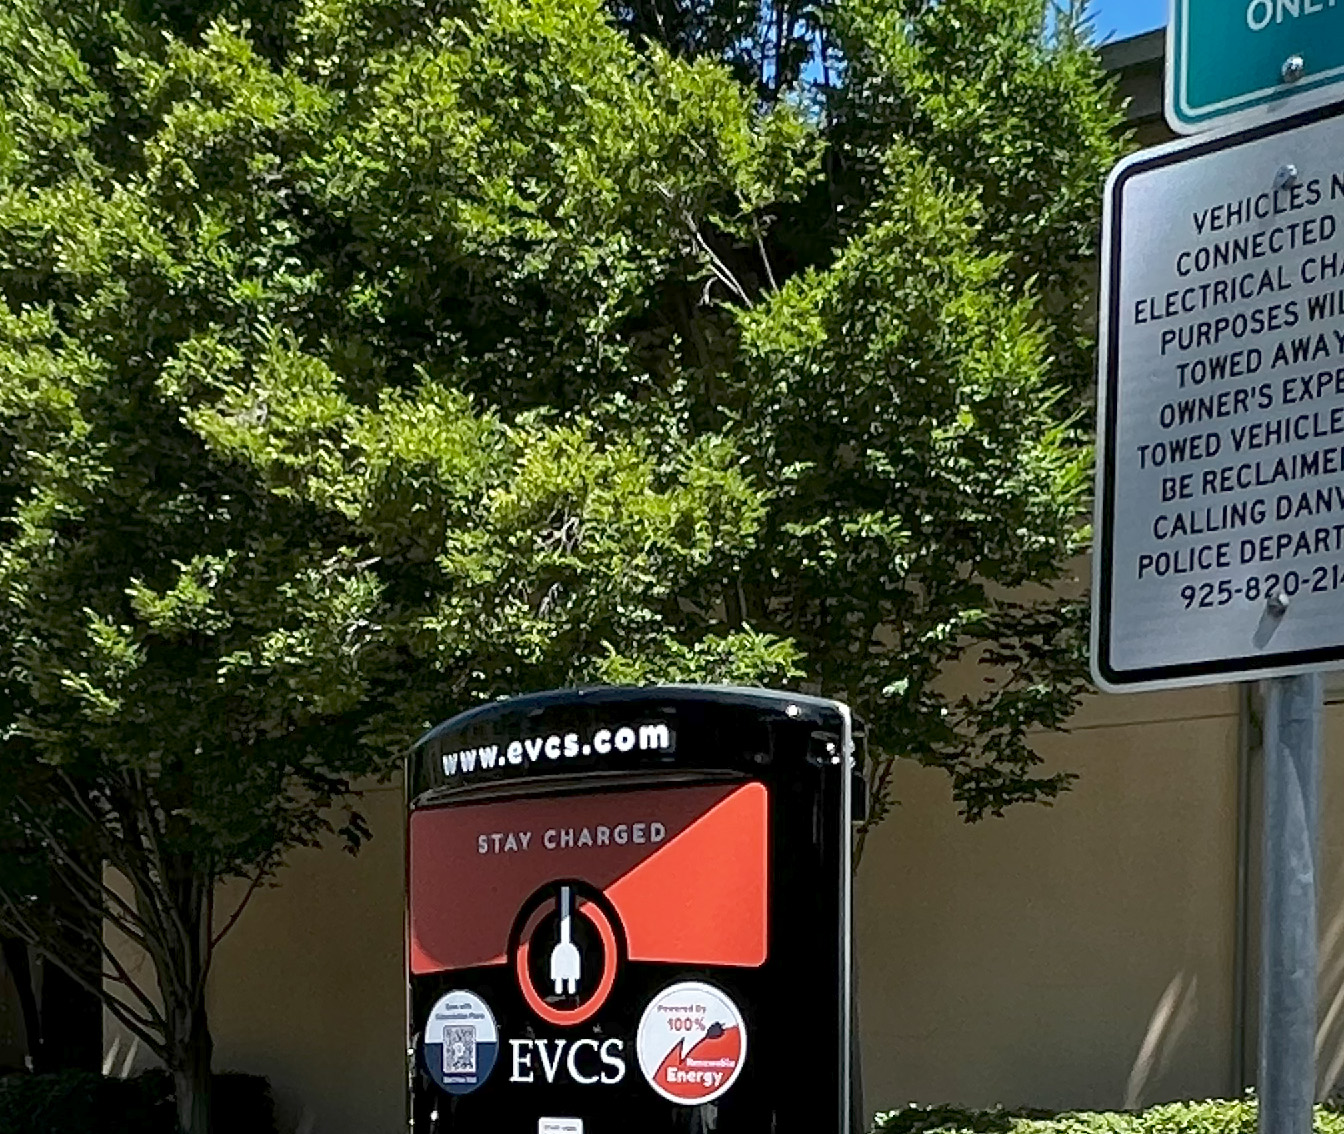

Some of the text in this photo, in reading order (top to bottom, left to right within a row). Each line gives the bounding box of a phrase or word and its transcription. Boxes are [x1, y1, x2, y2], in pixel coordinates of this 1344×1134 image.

[1193, 179, 1321, 235] VEHICLES
[1176, 214, 1336, 277] CONNECTED
[1134, 265, 1292, 324] ELECTRICAL
[1161, 301, 1299, 355] PURPOSES
[1176, 348, 1262, 388] TOWED
[1160, 383, 1273, 429] OWNER'S
[1137, 432, 1221, 469] TOWED
[1161, 473, 1193, 502] BE
[1153, 499, 1266, 540] CALLING
[1138, 542, 1231, 579] POLICE
[442, 723, 670, 776] www.evcs.com
[478, 822, 667, 854] STAY CHARGED
[657, 1004, 693, 1013] Powered
[667, 1016, 706, 1031] 100%
[509, 1038, 626, 1084] EVCS
[666, 1067, 724, 1087] Energy
